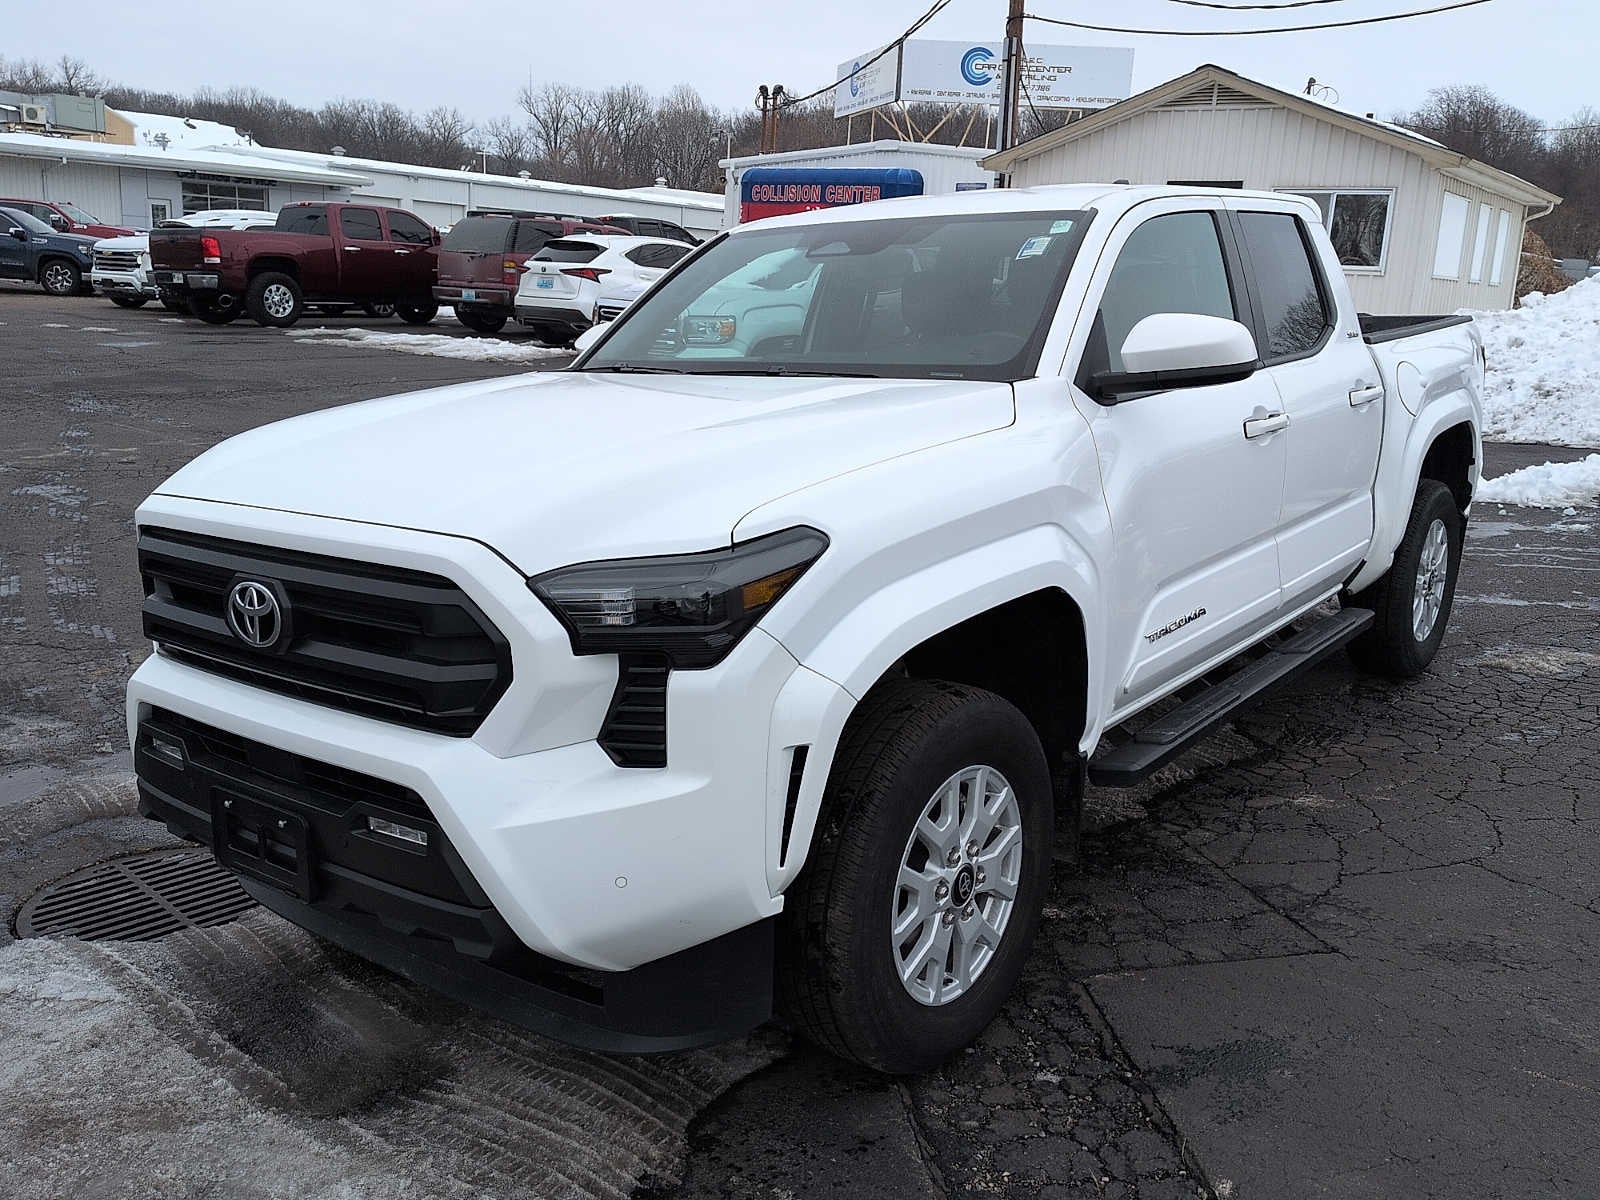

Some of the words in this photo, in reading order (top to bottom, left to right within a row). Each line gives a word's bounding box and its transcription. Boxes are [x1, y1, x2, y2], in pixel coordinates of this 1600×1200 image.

[975, 63, 997, 71] CAR
[998, 64, 1025, 72] CE
[1028, 65, 1072, 74] CENTER
[751, 184, 821, 202] COLLISION
[825, 185, 881, 203] CENTER
[1144, 607, 1207, 643] TACOMA
